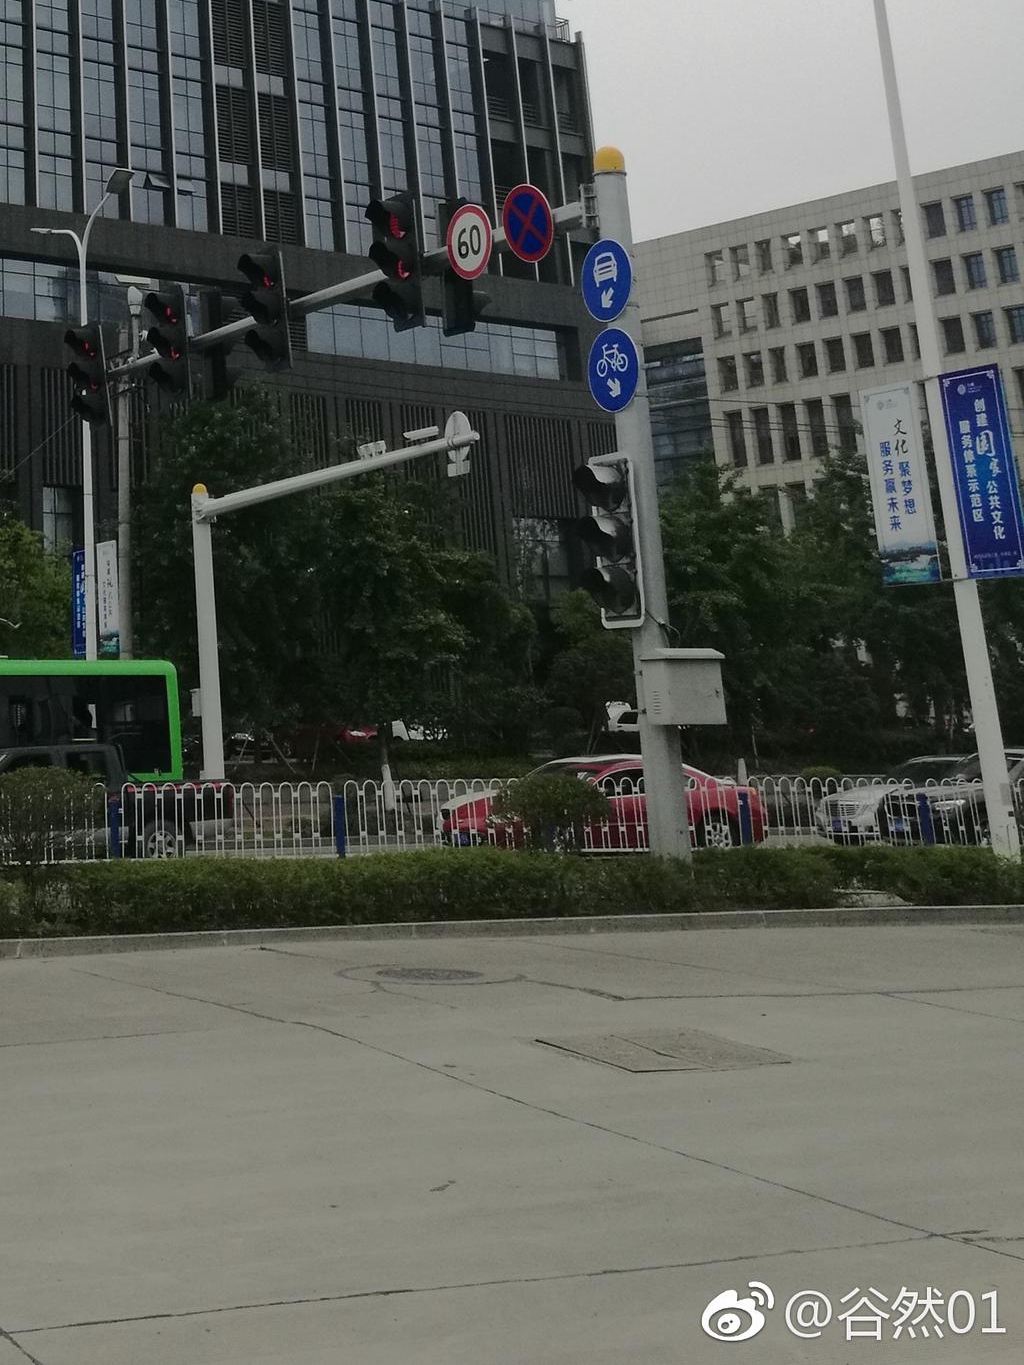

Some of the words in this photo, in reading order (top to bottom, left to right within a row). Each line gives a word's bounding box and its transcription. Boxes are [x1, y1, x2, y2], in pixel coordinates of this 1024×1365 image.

[457, 224, 481, 259] 60
[879, 441, 902, 532] 服务赢未来
[959, 420, 984, 522] 服务体系示范区
